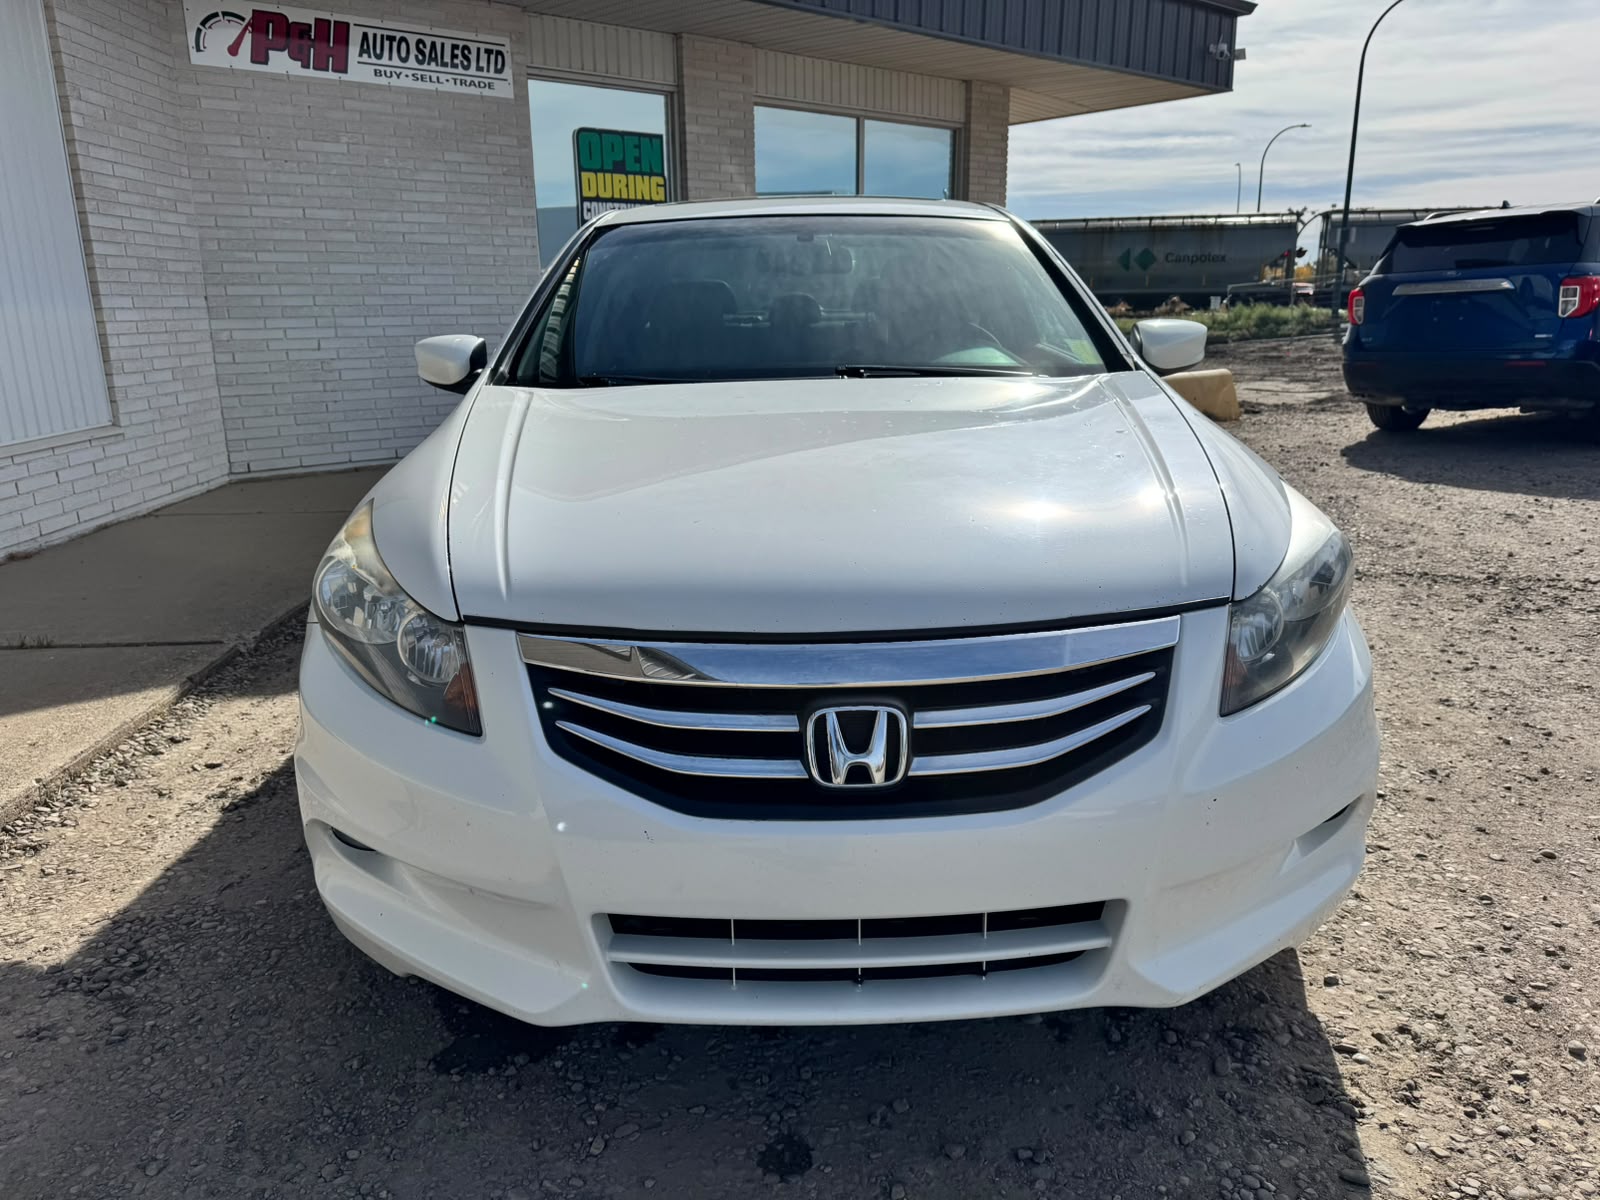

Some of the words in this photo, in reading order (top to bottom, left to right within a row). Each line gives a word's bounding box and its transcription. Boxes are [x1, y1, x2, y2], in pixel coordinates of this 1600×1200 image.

[358, 31, 411, 64] AUTO
[414, 38, 472, 71] SALES
[475, 46, 506, 75] LTD
[373, 68, 403, 80] BUY
[411, 72, 444, 84] SELL
[451, 77, 496, 90] TRADE
[578, 131, 663, 174] OPEN
[581, 171, 665, 202] DURING
[1165, 252, 1227, 266] Canpotex
